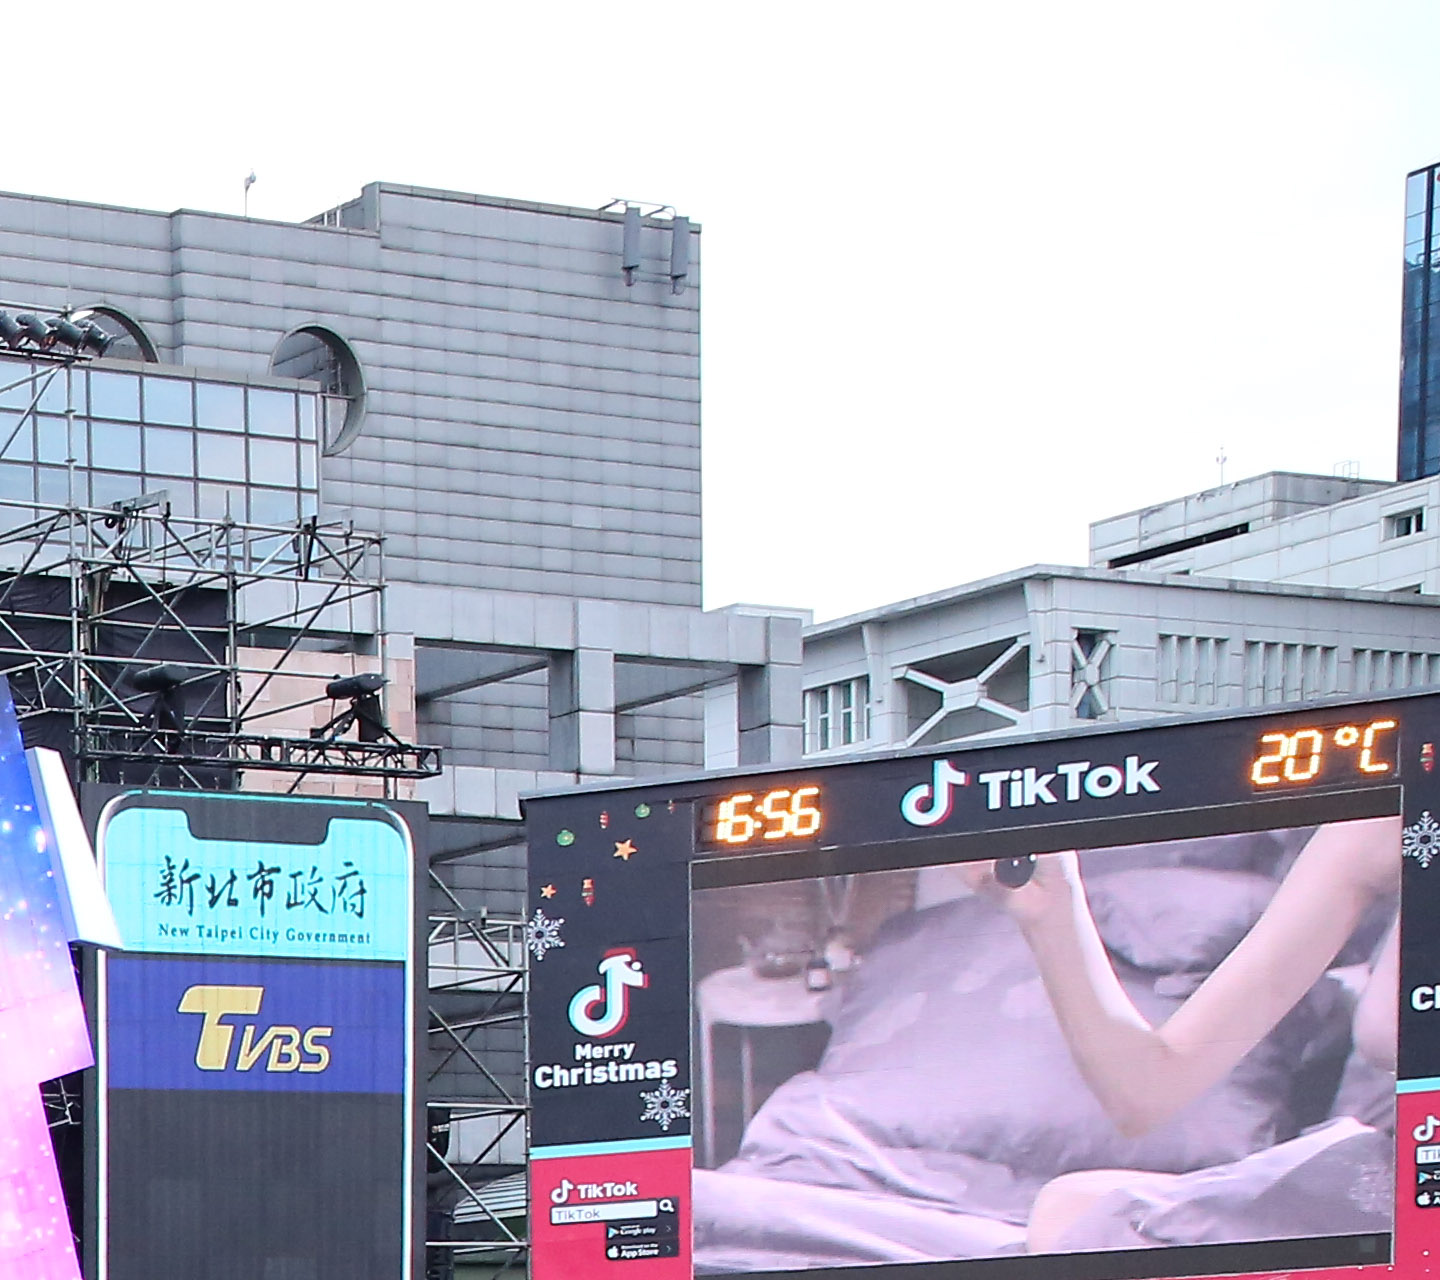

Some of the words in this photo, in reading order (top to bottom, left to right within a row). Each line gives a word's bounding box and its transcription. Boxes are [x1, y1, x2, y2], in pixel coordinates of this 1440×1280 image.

[978, 755, 1161, 811] TikTok
[714, 786, 821, 843] 16:56
[153, 854, 367, 920] 新北市政府
[158, 923, 190, 937] New
[195, 924, 243, 942] Taipei
[249, 926, 279, 944] City
[286, 927, 371, 944] Government
[177, 983, 333, 1073] TVBS
[574, 1042, 636, 1061] Merry
[534, 1059, 678, 1089] Christmas
[576, 1181, 638, 1200] TikTok
[555, 1208, 600, 1222] TikTok
